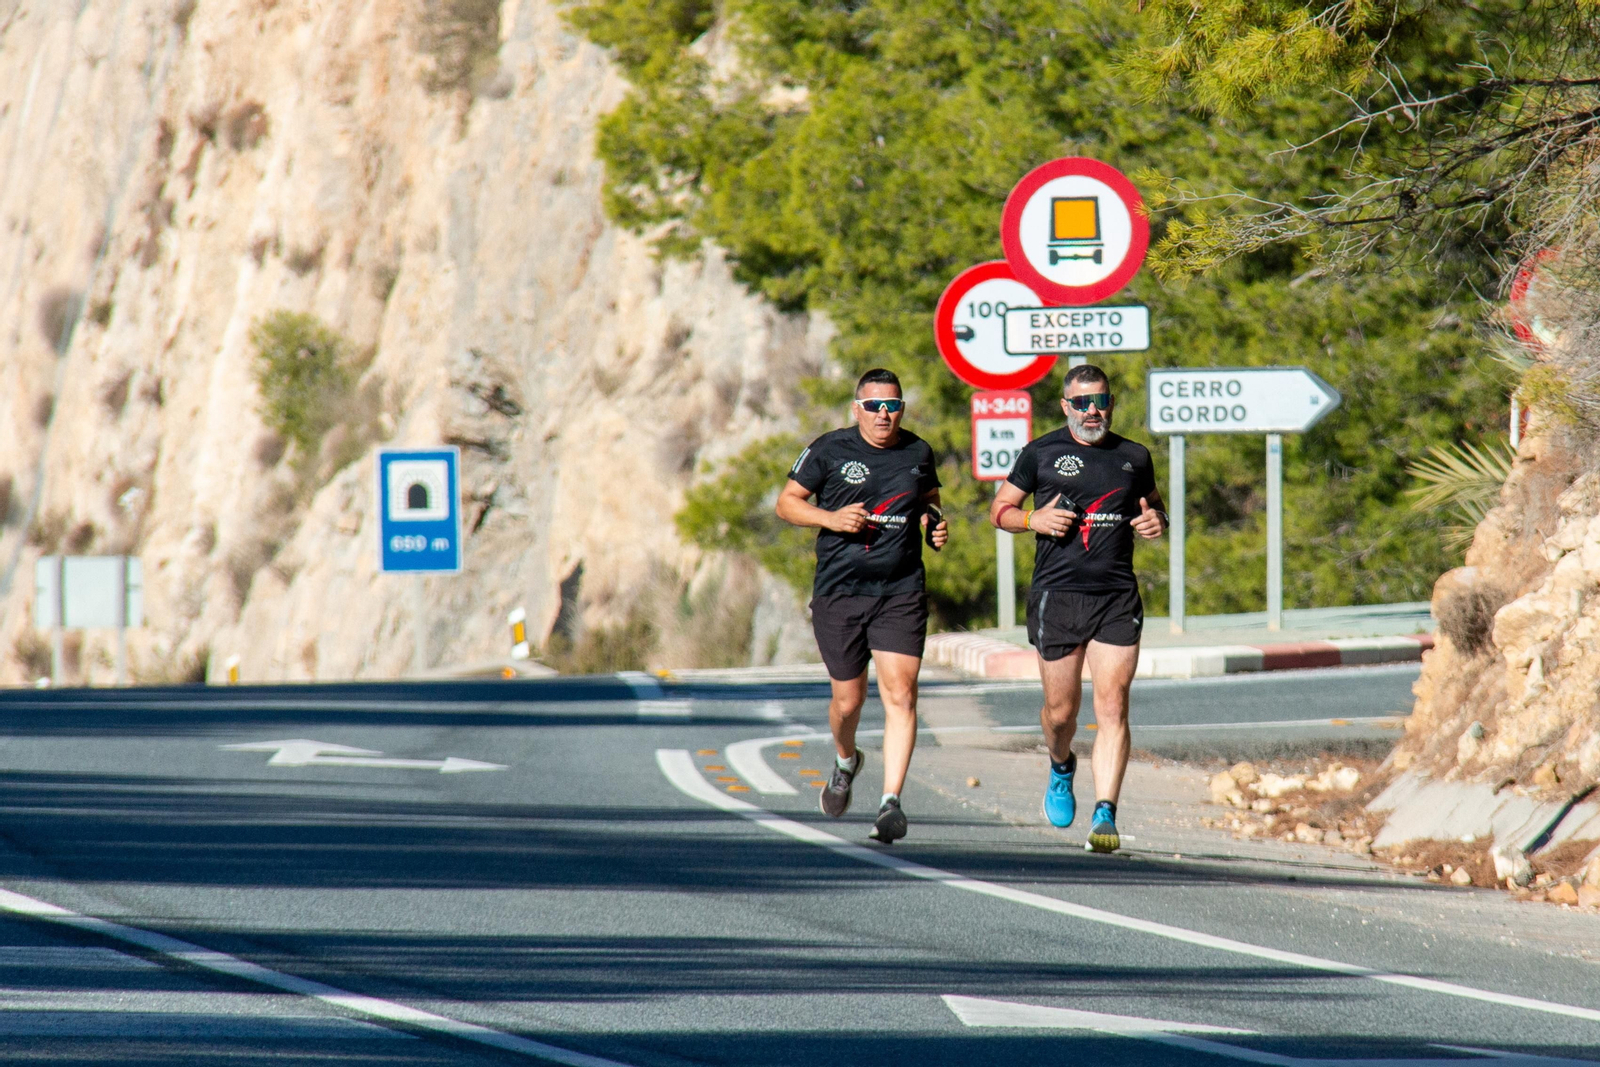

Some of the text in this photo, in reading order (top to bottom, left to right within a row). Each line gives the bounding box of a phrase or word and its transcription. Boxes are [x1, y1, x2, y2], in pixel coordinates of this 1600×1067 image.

[968, 301, 1008, 318] 100
[1030, 311, 1123, 328] EXCEPTO
[1031, 331, 1123, 348] REPARTO
[1158, 379, 1242, 398] CERRO
[972, 397, 1030, 414] N-340
[1158, 404, 1247, 423] GORDO
[990, 427, 1015, 440] km
[431, 537, 450, 552] m
